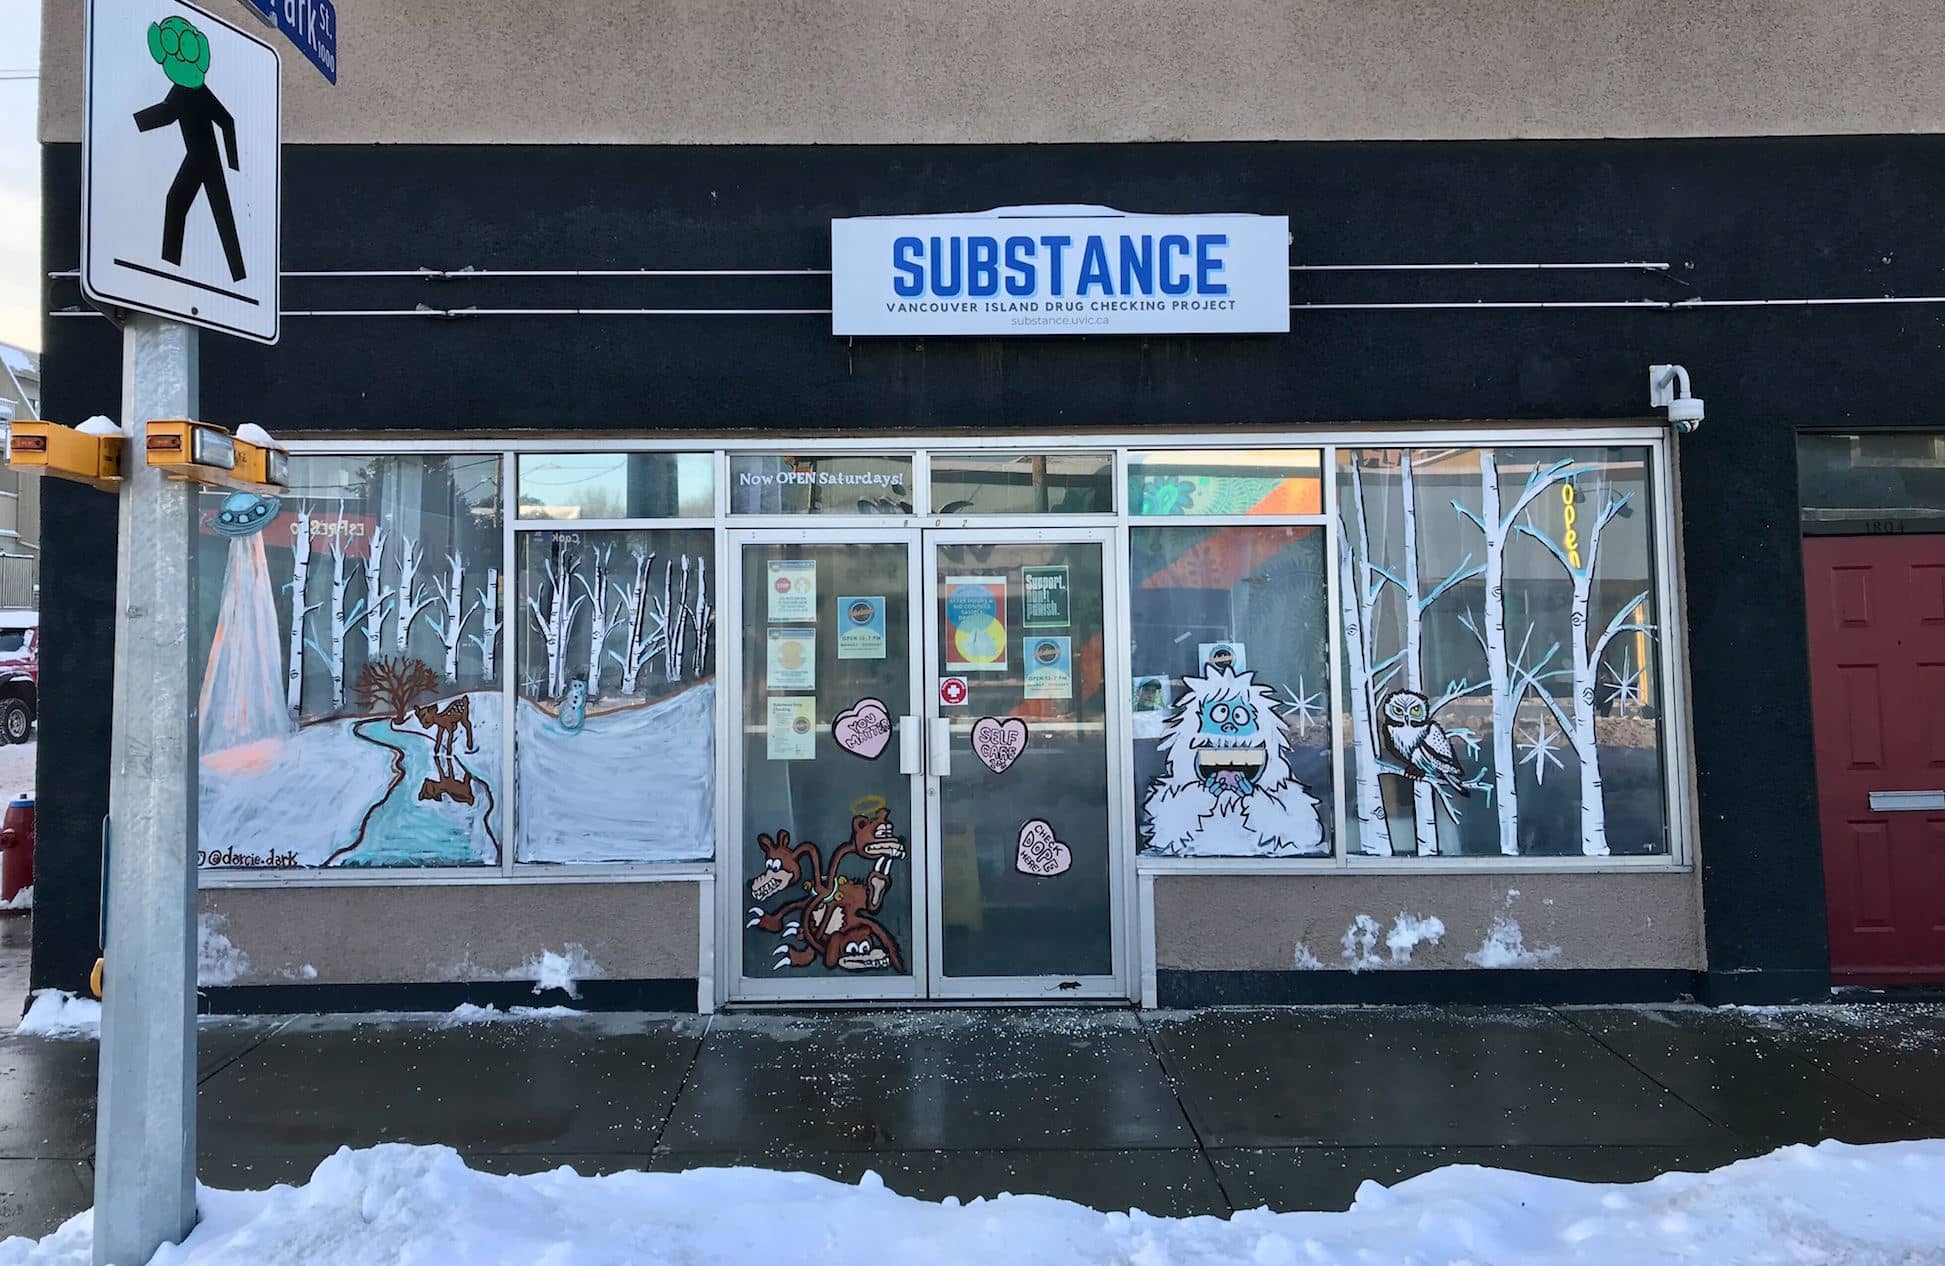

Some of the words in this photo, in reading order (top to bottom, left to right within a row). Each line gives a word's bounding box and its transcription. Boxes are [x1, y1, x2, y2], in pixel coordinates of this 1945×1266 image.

[270, 0, 317, 52] ark
[320, 3, 333, 40] St.
[318, 40, 335, 73] 1000
[893, 234, 1229, 297] SUBSTANCE
[886, 301, 978, 313] VANCOUVER
[985, 301, 1039, 312] ISLAND
[1045, 301, 1085, 312] DRUG
[1090, 301, 1167, 311] CHECKING
[1172, 300, 1236, 310] PROJECT
[1011, 315, 1110, 326] substance.uvic.ca
[740, 473, 773, 485] Now
[776, 472, 816, 485] OPEN
[819, 472, 903, 488] Saturdays!
[1562, 484, 1581, 569] open
[845, 718, 890, 749] MATTER
[847, 713, 876, 734] YOU
[979, 726, 1019, 746] SELF
[980, 744, 1017, 760] CARE
[1022, 830, 1059, 873] DOPE
[1034, 824, 1063, 857] CHECK
[208, 845, 299, 866] @darcie.dark
